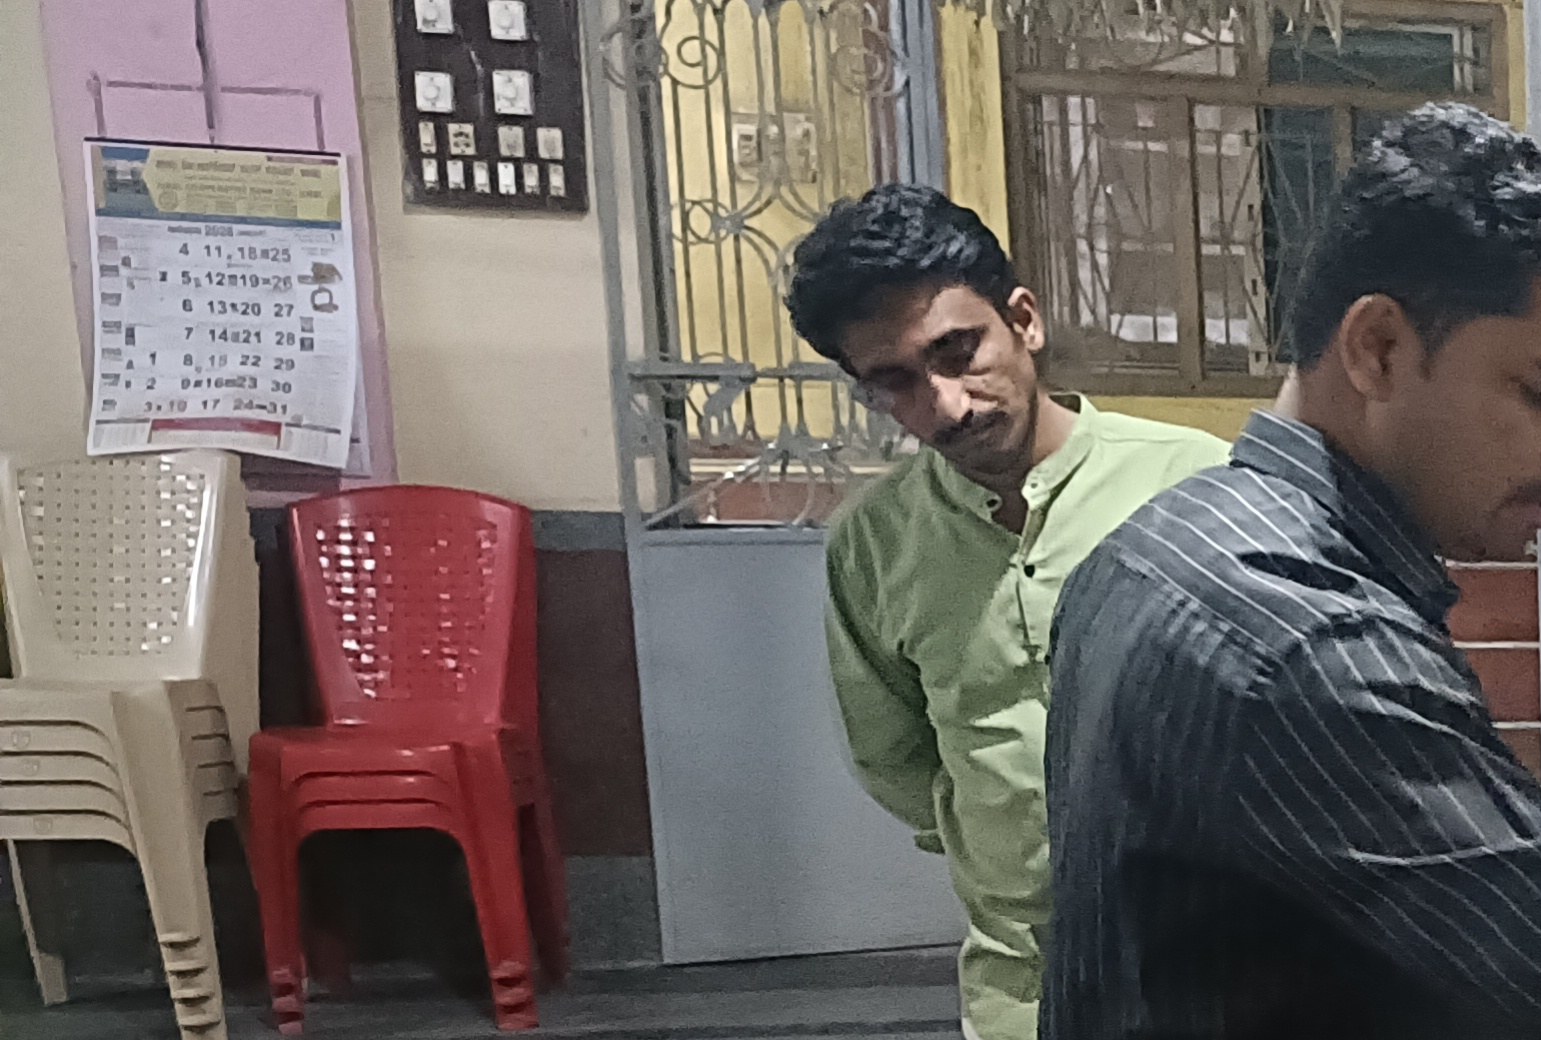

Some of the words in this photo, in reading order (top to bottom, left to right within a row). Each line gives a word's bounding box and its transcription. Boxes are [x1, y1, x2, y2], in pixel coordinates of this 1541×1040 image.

[179, 243, 189, 256] 4
[204, 245, 222, 257] 11
[237, 247, 257, 260] 18
[270, 248, 291, 262] 25
[181, 271, 191, 285] 5
[205, 271, 226, 286] 12
[240, 274, 259, 287] 19
[207, 301, 227, 314] 13
[240, 302, 261, 316] 20
[274, 303, 294, 317] 27
[185, 327, 193, 340] 7
[209, 328, 228, 342] 14
[242, 330, 261, 343] 21
[275, 331, 296, 346] 28
[150, 351, 157, 366] 1
[183, 353, 193, 366] 8
[239, 354, 261, 367] 22
[273, 357, 295, 371] 29
[146, 377, 156, 390] 2
[207, 377, 224, 389] 16
[271, 380, 292, 394] 30
[202, 399, 220, 410] 17
[267, 402, 287, 415] 31
